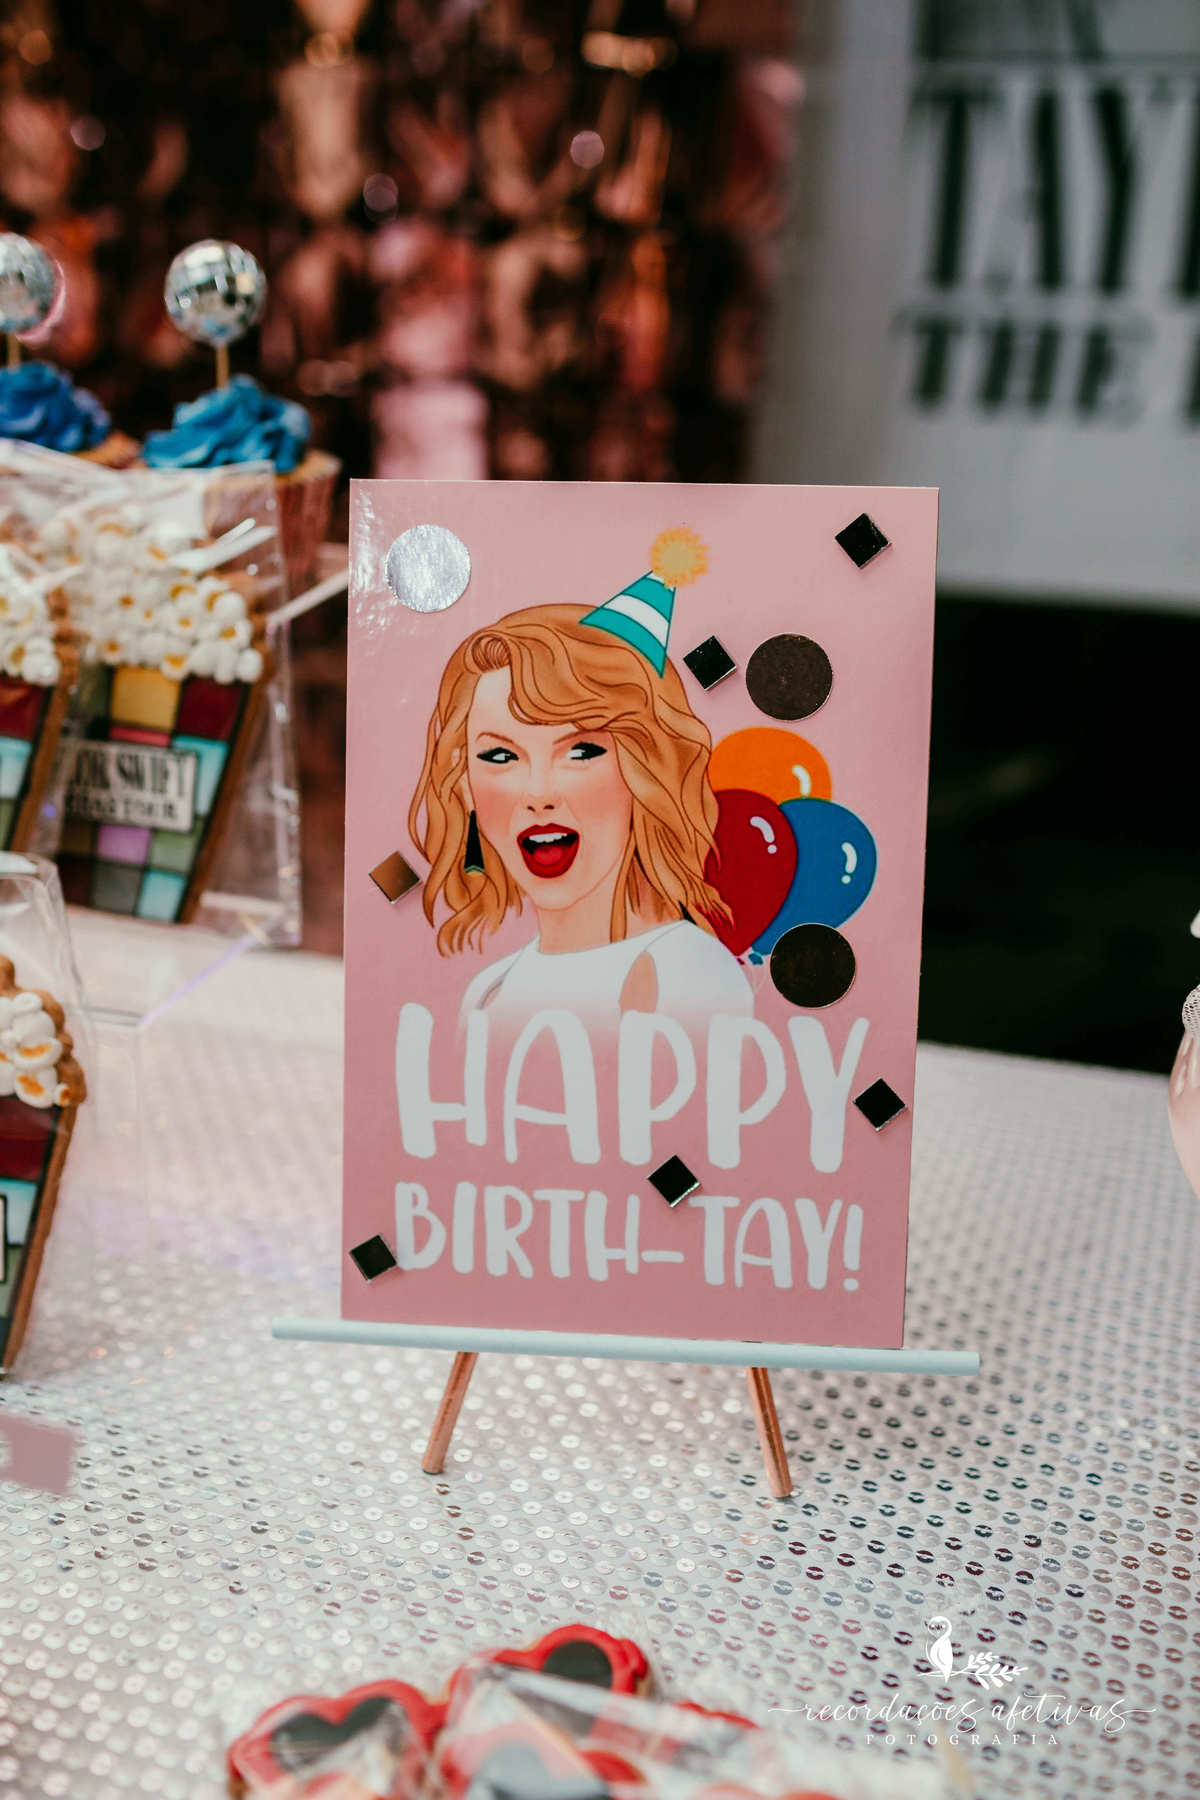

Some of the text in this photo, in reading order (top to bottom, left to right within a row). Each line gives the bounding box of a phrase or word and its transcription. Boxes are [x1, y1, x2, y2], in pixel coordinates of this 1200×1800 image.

[895, 312, 1150, 424] THE
[396, 1002, 870, 1174] HAPPY
[395, 1181, 863, 1292] BIRTH-TAY!
